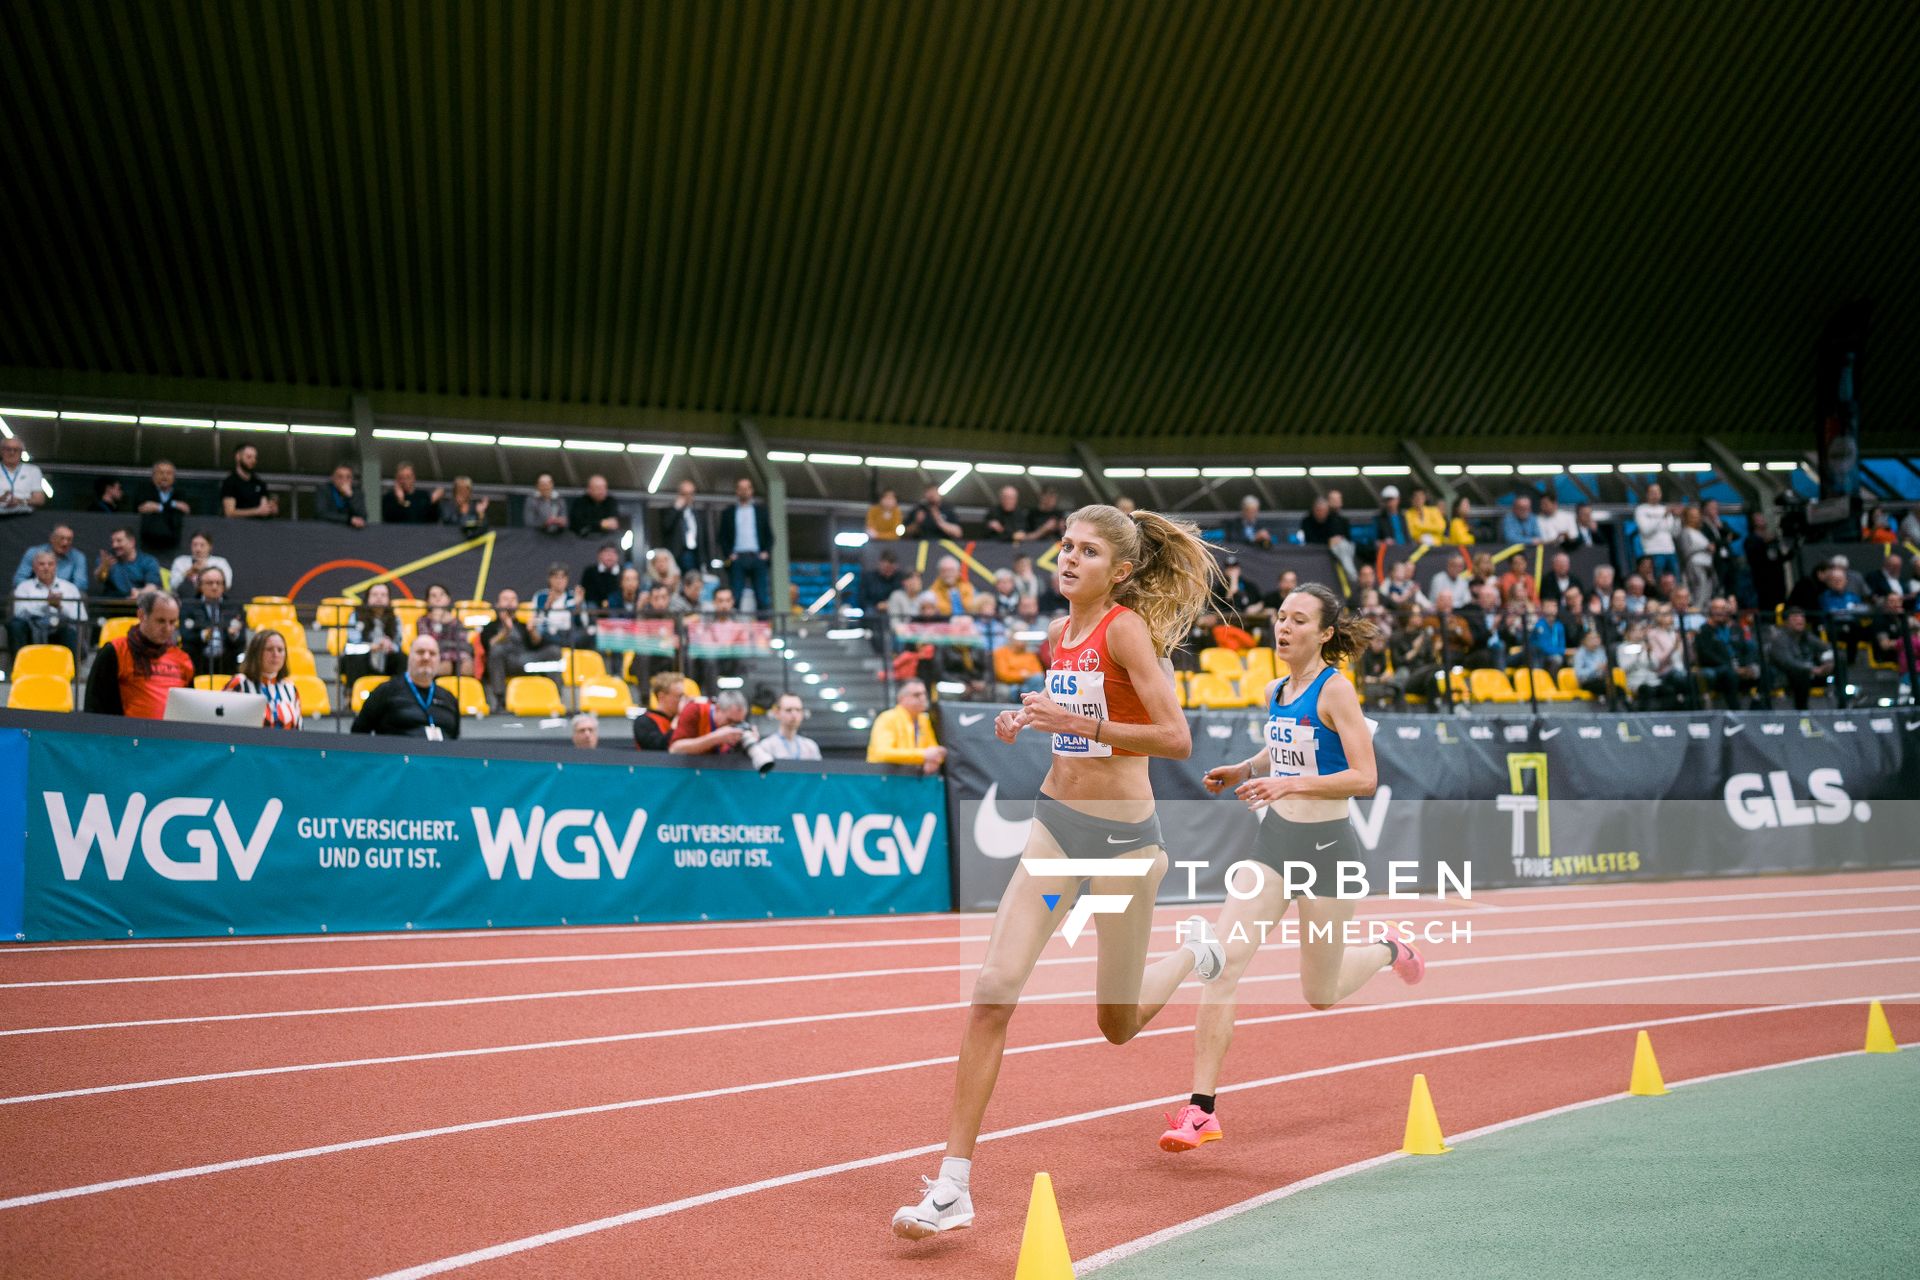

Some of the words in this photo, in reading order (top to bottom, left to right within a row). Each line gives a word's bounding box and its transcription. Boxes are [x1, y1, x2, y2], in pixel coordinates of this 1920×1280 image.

[1063, 735, 1087, 745] PLAN
[1724, 768, 1871, 830] GLS.
[43, 791, 283, 881] WGV
[297, 817, 339, 839] GUT
[341, 818, 459, 841] VERSICHERT.
[657, 824, 690, 843] GUT
[690, 824, 785, 844] VERSICHERT.
[471, 806, 648, 880] WGV
[792, 811, 937, 877] WGV
[319, 847, 361, 868] UND
[365, 848, 404, 869] GUT
[407, 848, 441, 869] IST.
[674, 848, 708, 868] UND
[709, 848, 742, 868] GUT
[744, 848, 772, 868] IST.
